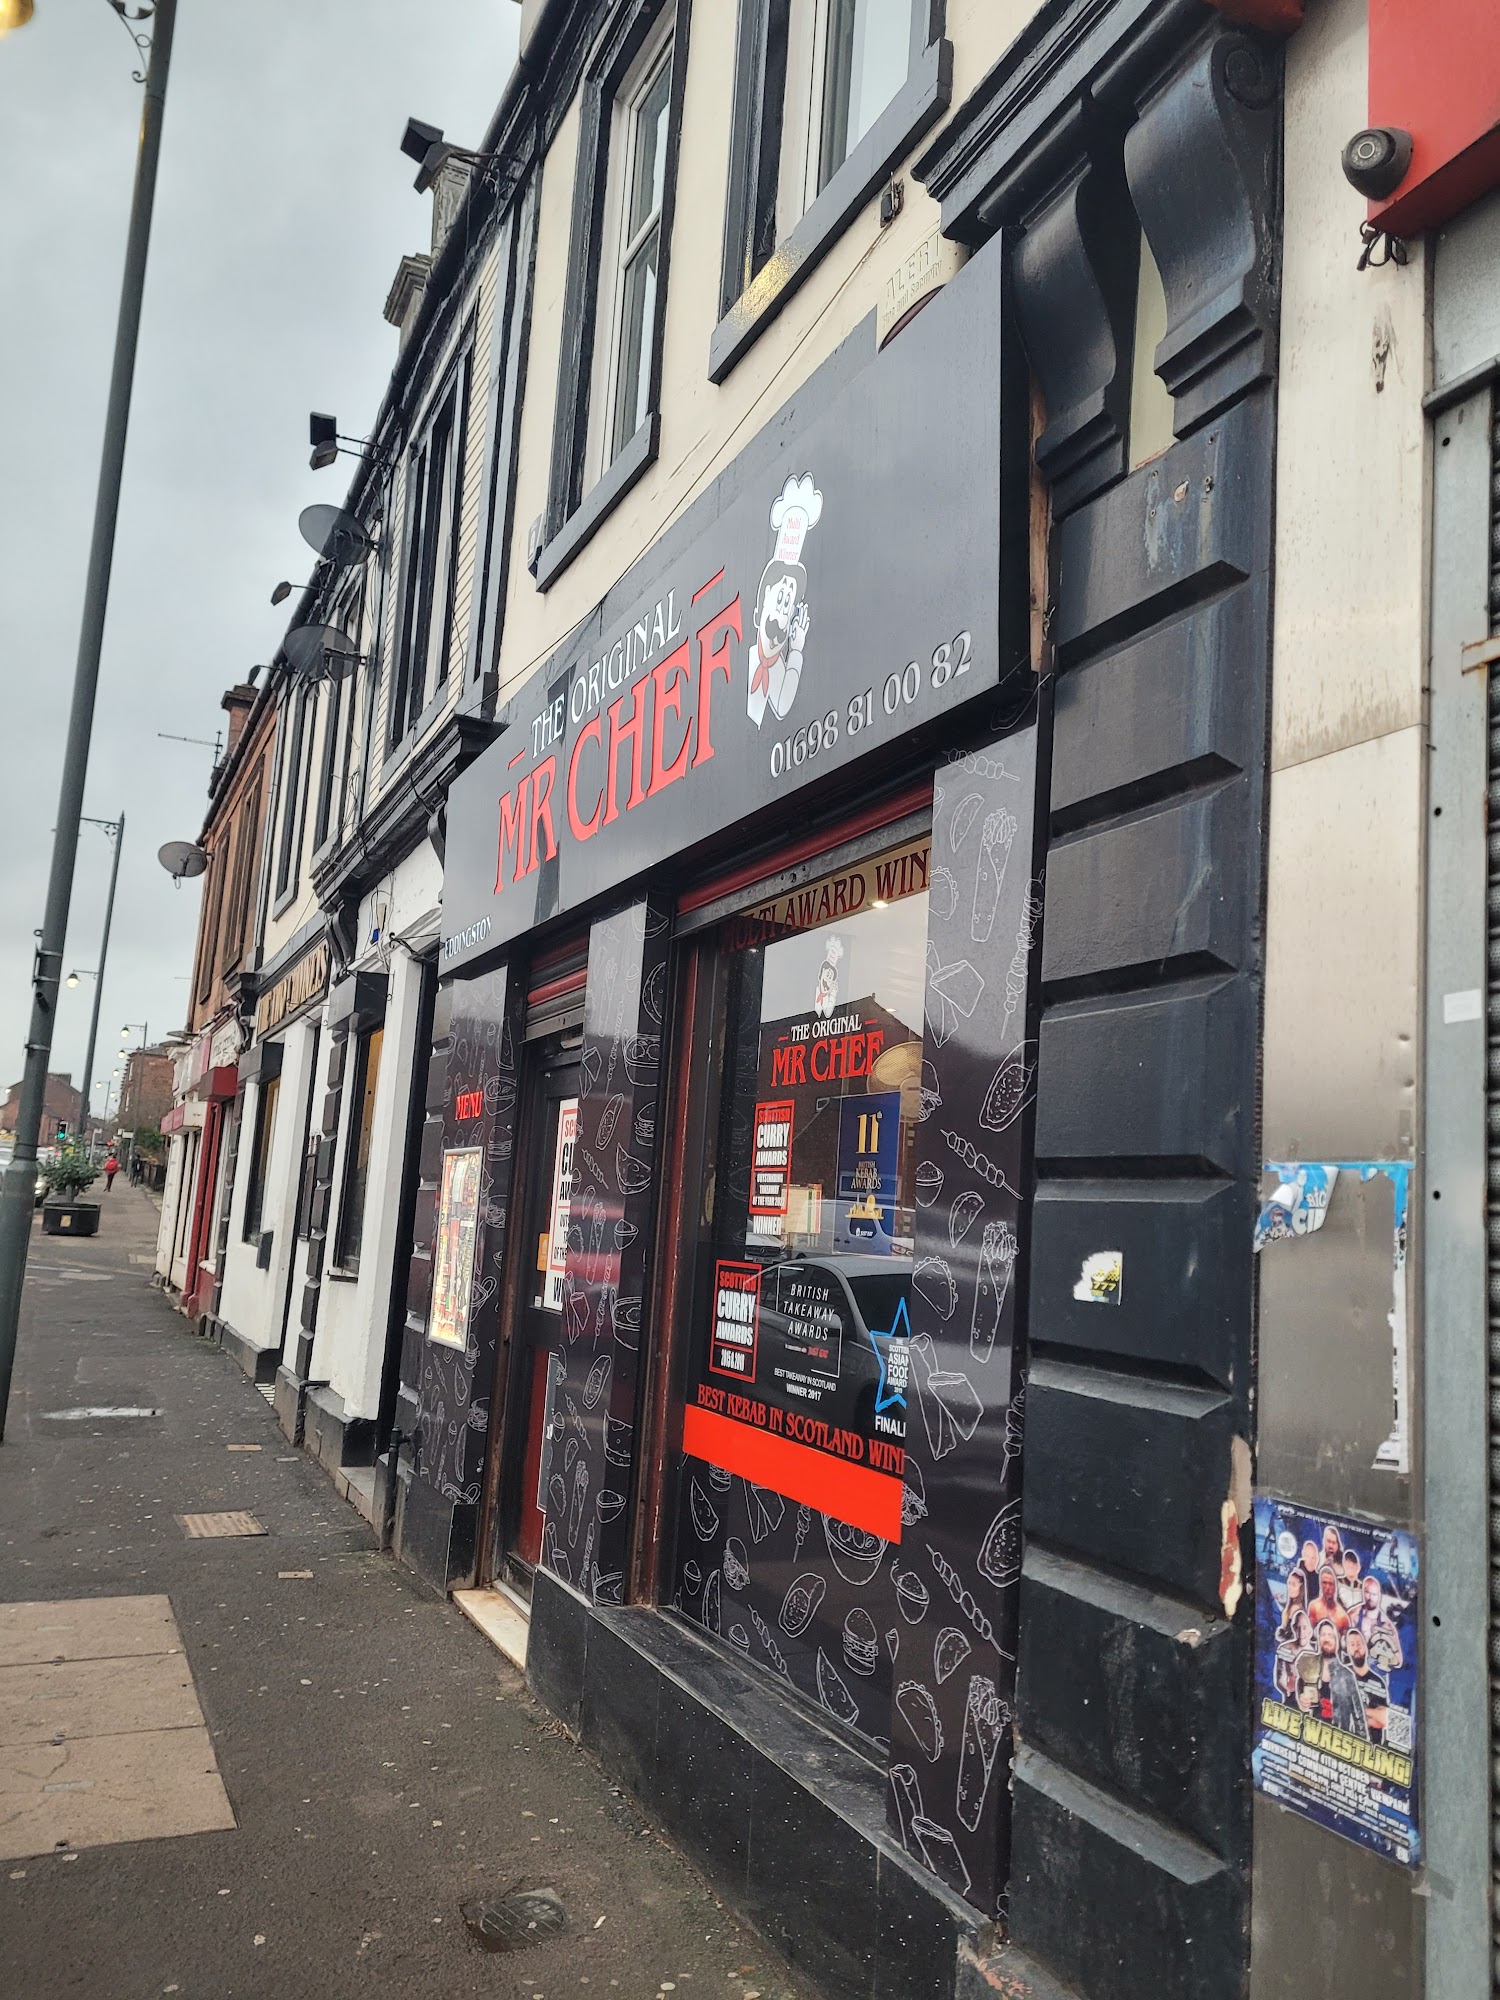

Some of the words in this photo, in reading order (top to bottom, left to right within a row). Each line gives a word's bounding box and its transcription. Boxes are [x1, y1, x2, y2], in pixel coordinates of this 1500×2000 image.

[531, 692, 565, 759] THE
[571, 587, 682, 724] ORIGINAL
[770, 709, 839, 778] 01698
[846, 687, 874, 736] 81
[883, 661, 921, 715] 00
[930, 630, 972, 689] 82
[494, 755, 557, 895] MR
[567, 591, 743, 841] CHEF
[782, 874, 866, 932] AWARD
[875, 847, 931, 900] WIN
[791, 1023, 810, 1042] THE
[812, 1014, 863, 1040] ORIGINAL
[771, 1044, 807, 1087] MR
[810, 1030, 884, 1082] CHEF
[455, 1091, 483, 1120] MENU
[757, 1122, 790, 1149] CURRY
[856, 1113, 880, 1154] 11
[755, 1150, 788, 1167] AWARDS
[851, 1177, 882, 1190] AWARDS
[855, 1168, 878, 1179] KEBAB
[753, 1214, 781, 1236] WINNER
[720, 1270, 757, 1291] SCOTTISH
[790, 1283, 829, 1301] BRITISH
[717, 1289, 756, 1324] CURRY
[783, 1300, 835, 1321] TAKEAWAY
[715, 1320, 754, 1346] AWARDS
[788, 1320, 829, 1341] AWARDS
[774, 1367, 786, 1377] BEST
[785, 1370, 807, 1383] TAKEAWAY
[812, 1377, 836, 1391] SCOTLAND
[786, 1383, 807, 1398] WINNER
[807, 1389, 821, 1401] 2017
[697, 1384, 725, 1411] BEST
[726, 1392, 766, 1426] KEBAB
[769, 1407, 783, 1432] IN
[786, 1412, 864, 1460] SCOTLAND
[868, 1438, 905, 1475] WIN
[1262, 1700, 1302, 1738] LIVE
[1304, 1716, 1412, 1787] WRESTLING!
